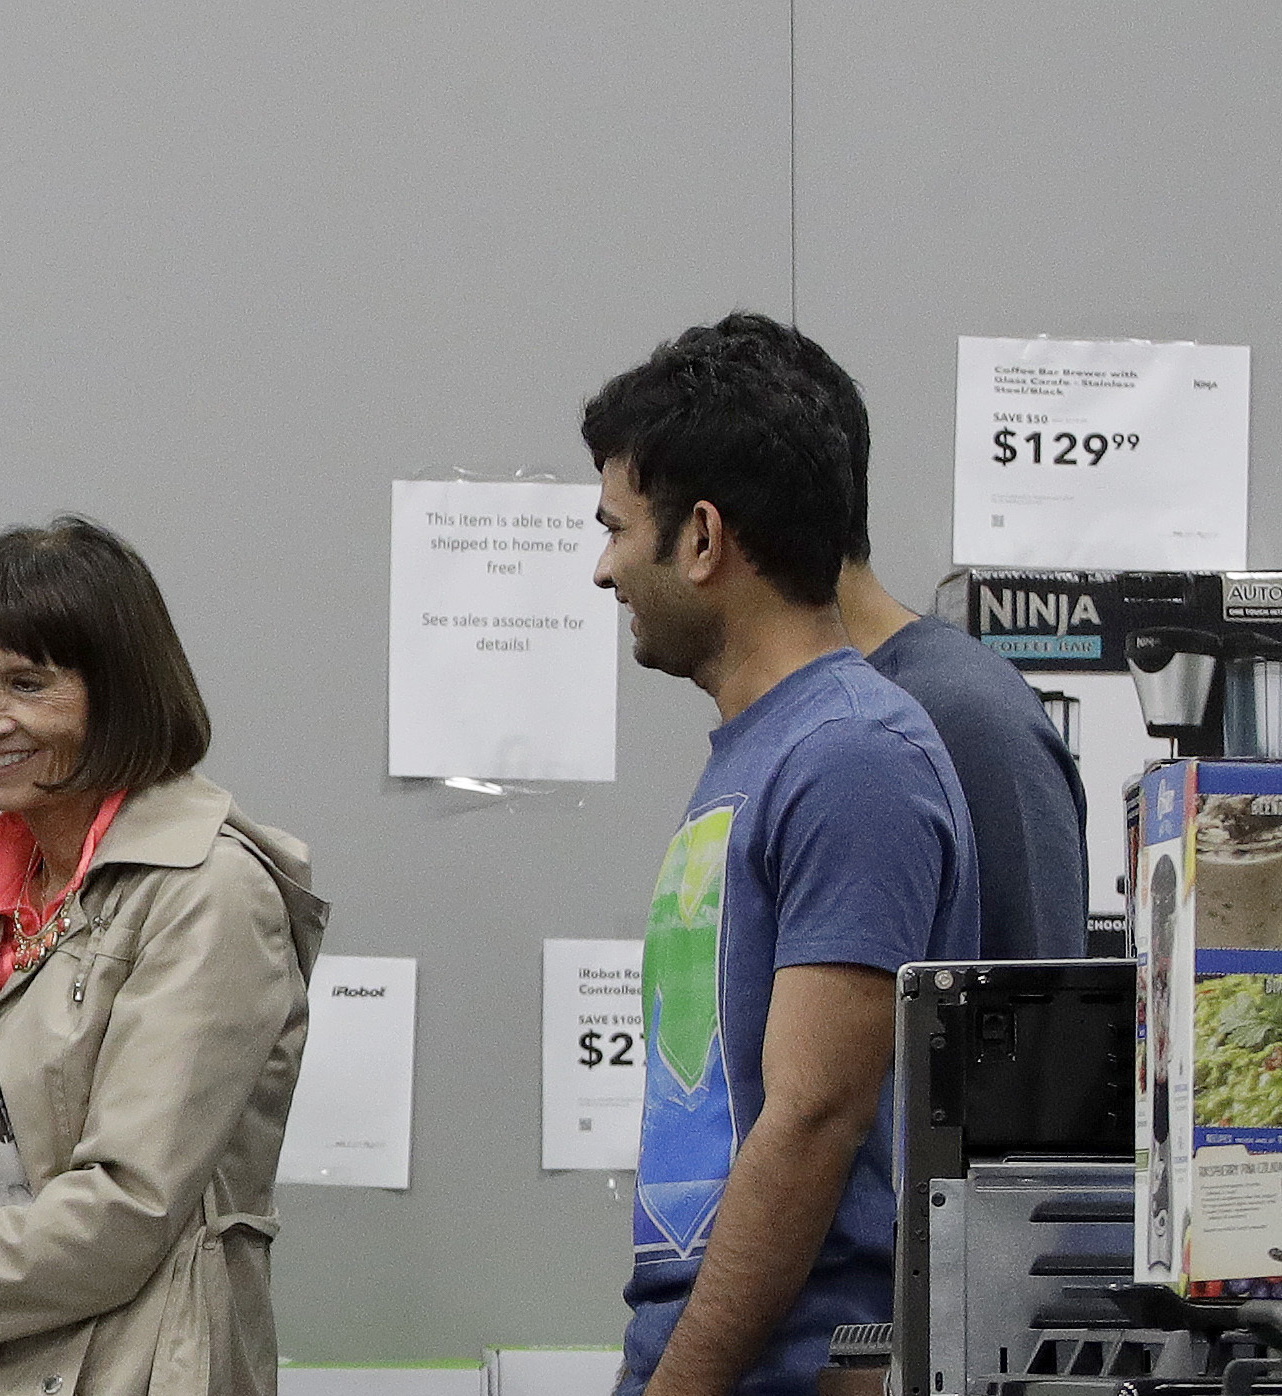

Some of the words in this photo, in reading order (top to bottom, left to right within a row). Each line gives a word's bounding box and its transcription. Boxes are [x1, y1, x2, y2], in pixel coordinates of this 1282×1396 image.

[1039, 368, 1059, 376] Bar
[1063, 369, 1107, 377] Brewer
[994, 376, 1026, 384] Glass
[1082, 379, 1136, 388] Stainless
[993, 413, 1022, 423] SAVE
[1026, 414, 1048, 424] $50
[425, 512, 455, 526] This
[459, 513, 492, 527] item
[496, 513, 507, 528] is
[512, 514, 543, 528] able
[547, 515, 561, 529] to
[565, 516, 584, 529] be
[431, 536, 488, 553] shipped
[492, 538, 507, 551] to
[512, 538, 553, 552] home
[557, 538, 578, 552] for
[487, 560, 522, 575] free!
[979, 585, 1101, 639] NINJA
[422, 613, 448, 628] See
[452, 613, 488, 628] sales
[492, 615, 559, 629] associate
[563, 615, 584, 629] for
[476, 637, 530, 652] details!
[1059, 640, 1093, 653] BAR
[579, 969, 620, 979] iRobot
[331, 986, 387, 997] iRobot
[579, 1015, 608, 1024] SAVE
[579, 1029, 645, 1069] $2
